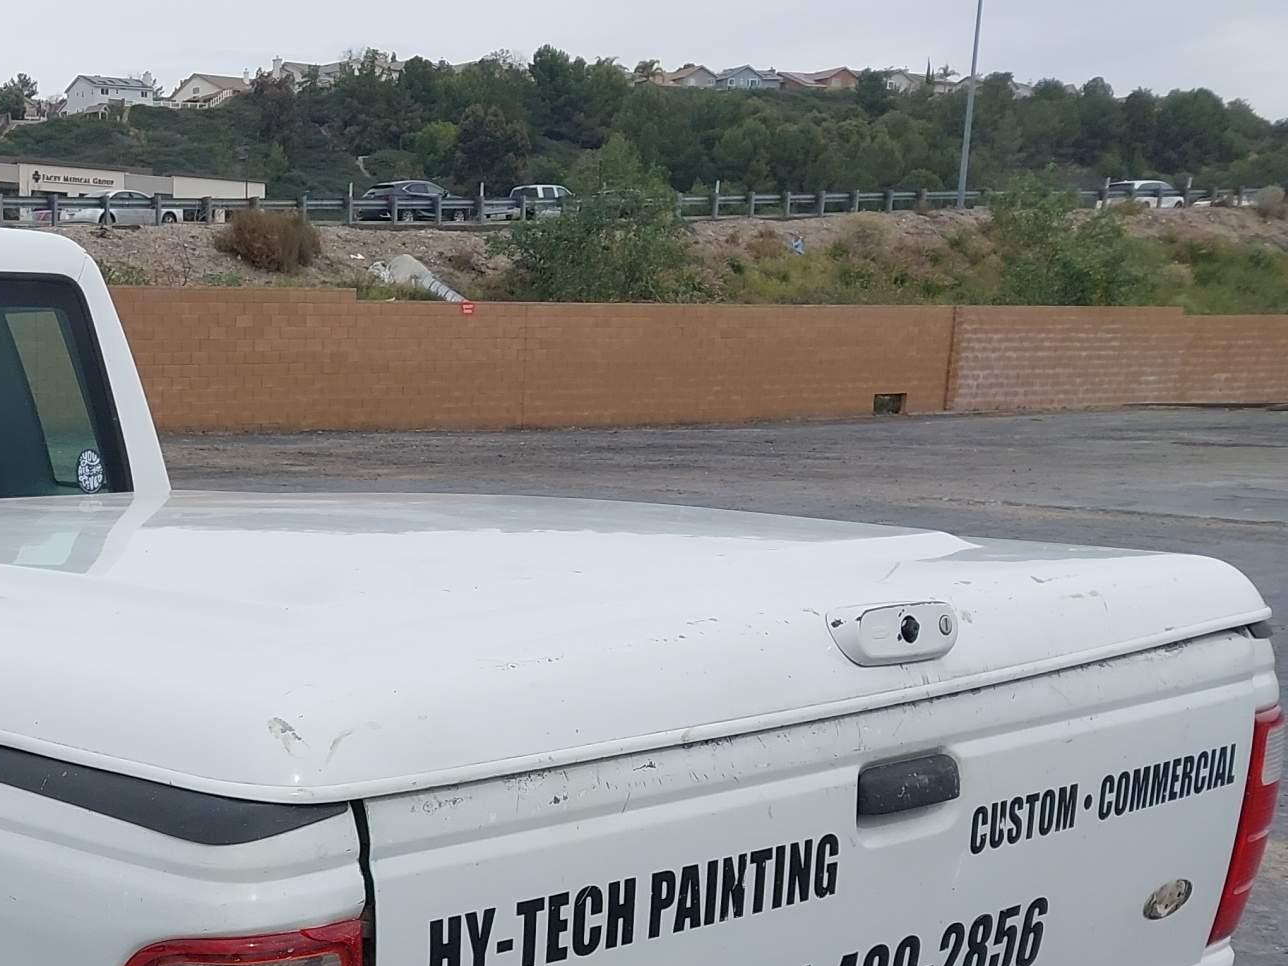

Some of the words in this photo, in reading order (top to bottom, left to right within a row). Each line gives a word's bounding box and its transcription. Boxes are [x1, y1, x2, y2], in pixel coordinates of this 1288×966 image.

[969, 783, 1079, 855] CUSTOM
[1097, 743, 1237, 821] COMMERCIAL
[647, 832, 840, 940] PAINTING
